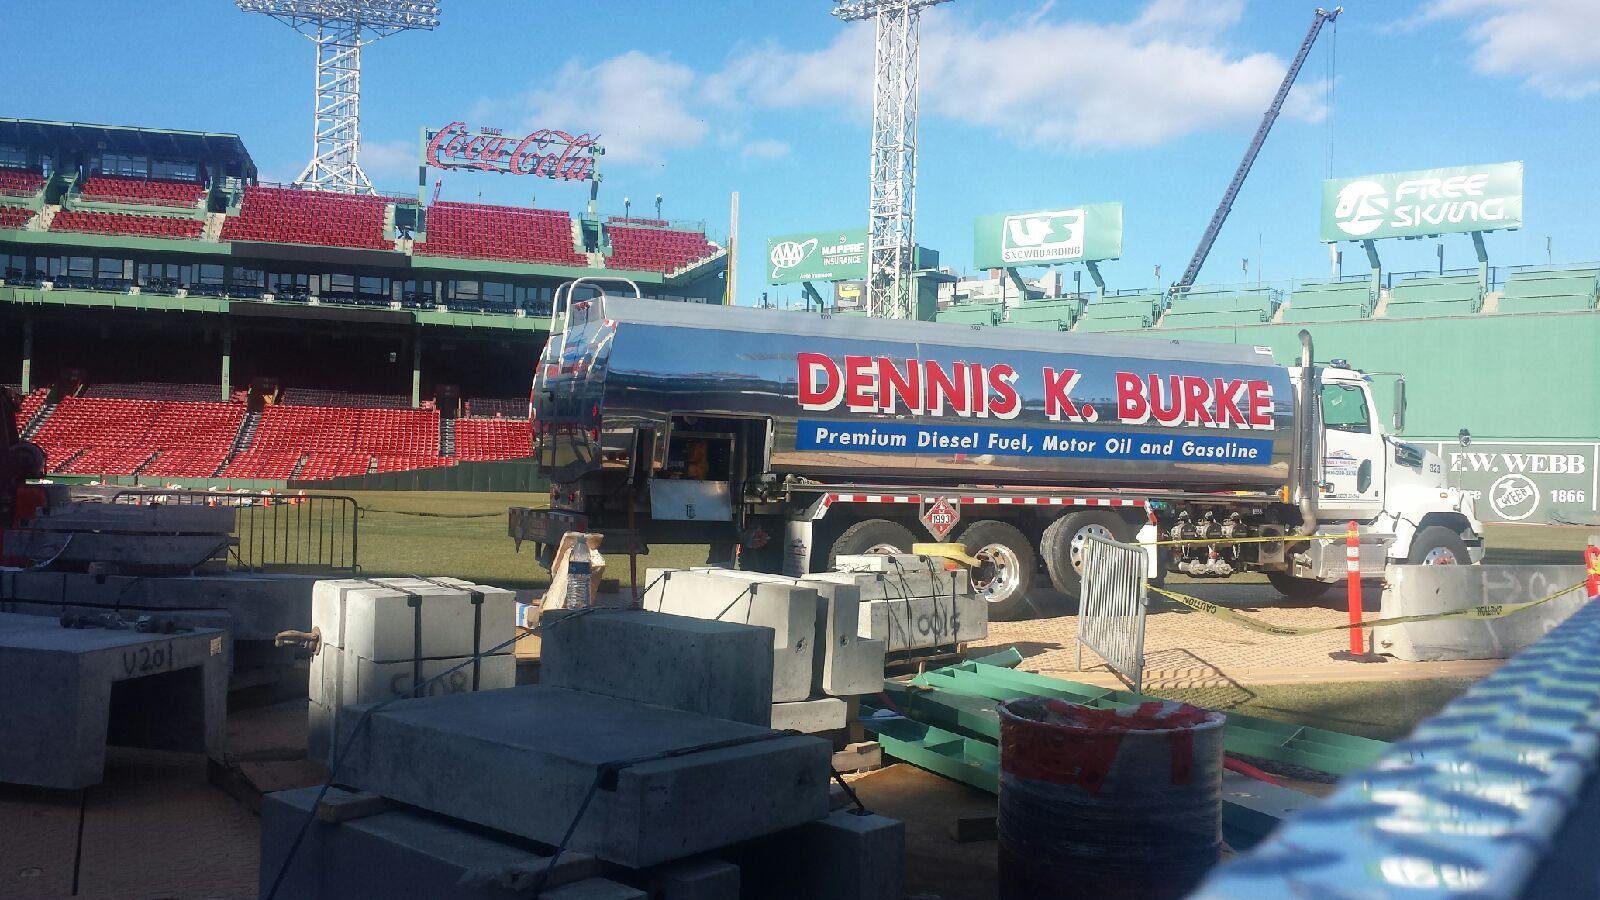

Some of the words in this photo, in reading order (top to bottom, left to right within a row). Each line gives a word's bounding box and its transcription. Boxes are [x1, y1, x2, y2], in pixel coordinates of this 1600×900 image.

[426, 121, 601, 180] Coca-Cola
[1396, 173, 1489, 201] FREE
[773, 243, 802, 259] AAA
[1004, 246, 1081, 260] SNOWBOARDING
[823, 255, 863, 266] INSURANCE
[797, 352, 1022, 420] DENNIS
[1042, 366, 1099, 423] K.
[1115, 371, 1275, 431] BURKE
[815, 427, 907, 447] Premium
[917, 431, 979, 449] Diesel
[987, 433, 1034, 453] Fuel,
[1042, 435, 1097, 453] Motor
[1105, 438, 1132, 454] Oil
[1140, 441, 1173, 456] and
[1181, 441, 1259, 459] Gasoline
[1429, 463, 1441, 474] 323
[1501, 453, 1586, 475] WEBB
[1501, 488, 1528, 505] WEBB
[1550, 489, 1585, 503] 1866
[932, 514, 950, 524] 1993
[1182, 596, 1217, 615] CAUTION
